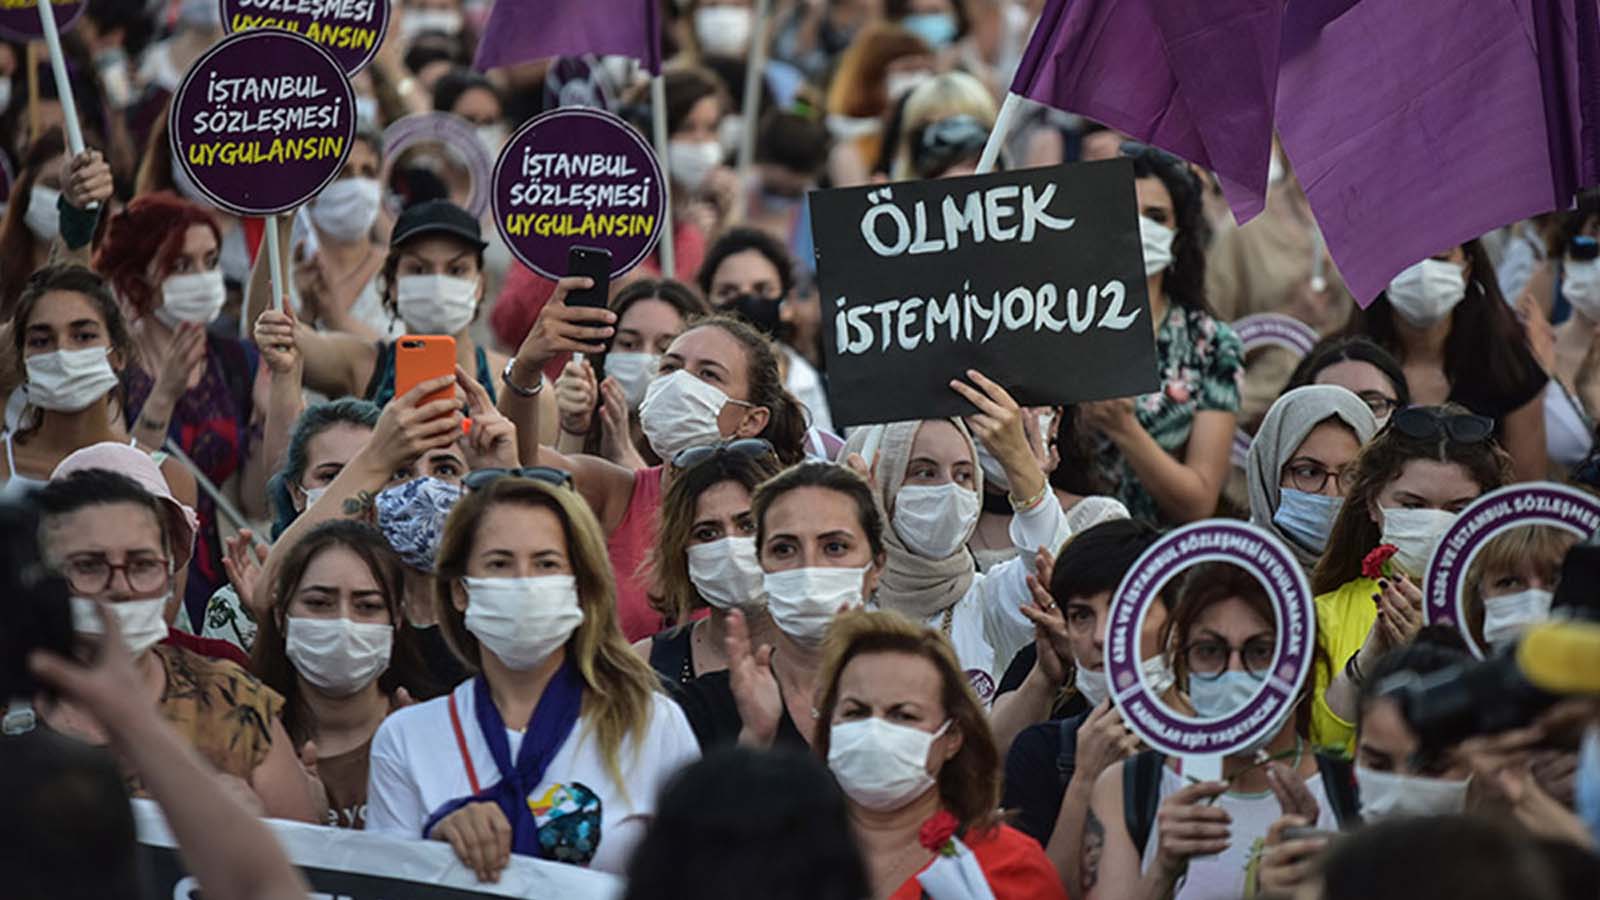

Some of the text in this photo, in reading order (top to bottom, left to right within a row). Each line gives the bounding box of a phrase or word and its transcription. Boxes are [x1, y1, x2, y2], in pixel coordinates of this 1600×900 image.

[232, 14, 376, 50] UYANSIN
[207, 71, 327, 103] İSTANBUL
[193, 97, 342, 135] SÖZLEŞMESİ
[189, 137, 343, 167] UYGULANSIN
[522, 146, 638, 179] İSTANBUL
[510, 177, 651, 212] SÖZLEŞMESİ
[506, 211, 654, 239] UYGULANSIN
[860, 183, 1076, 257] ÖLMEK
[1447, 501, 1513, 551] İSTANBUL
[1514, 493, 1600, 530] SÖZLEŞMES
